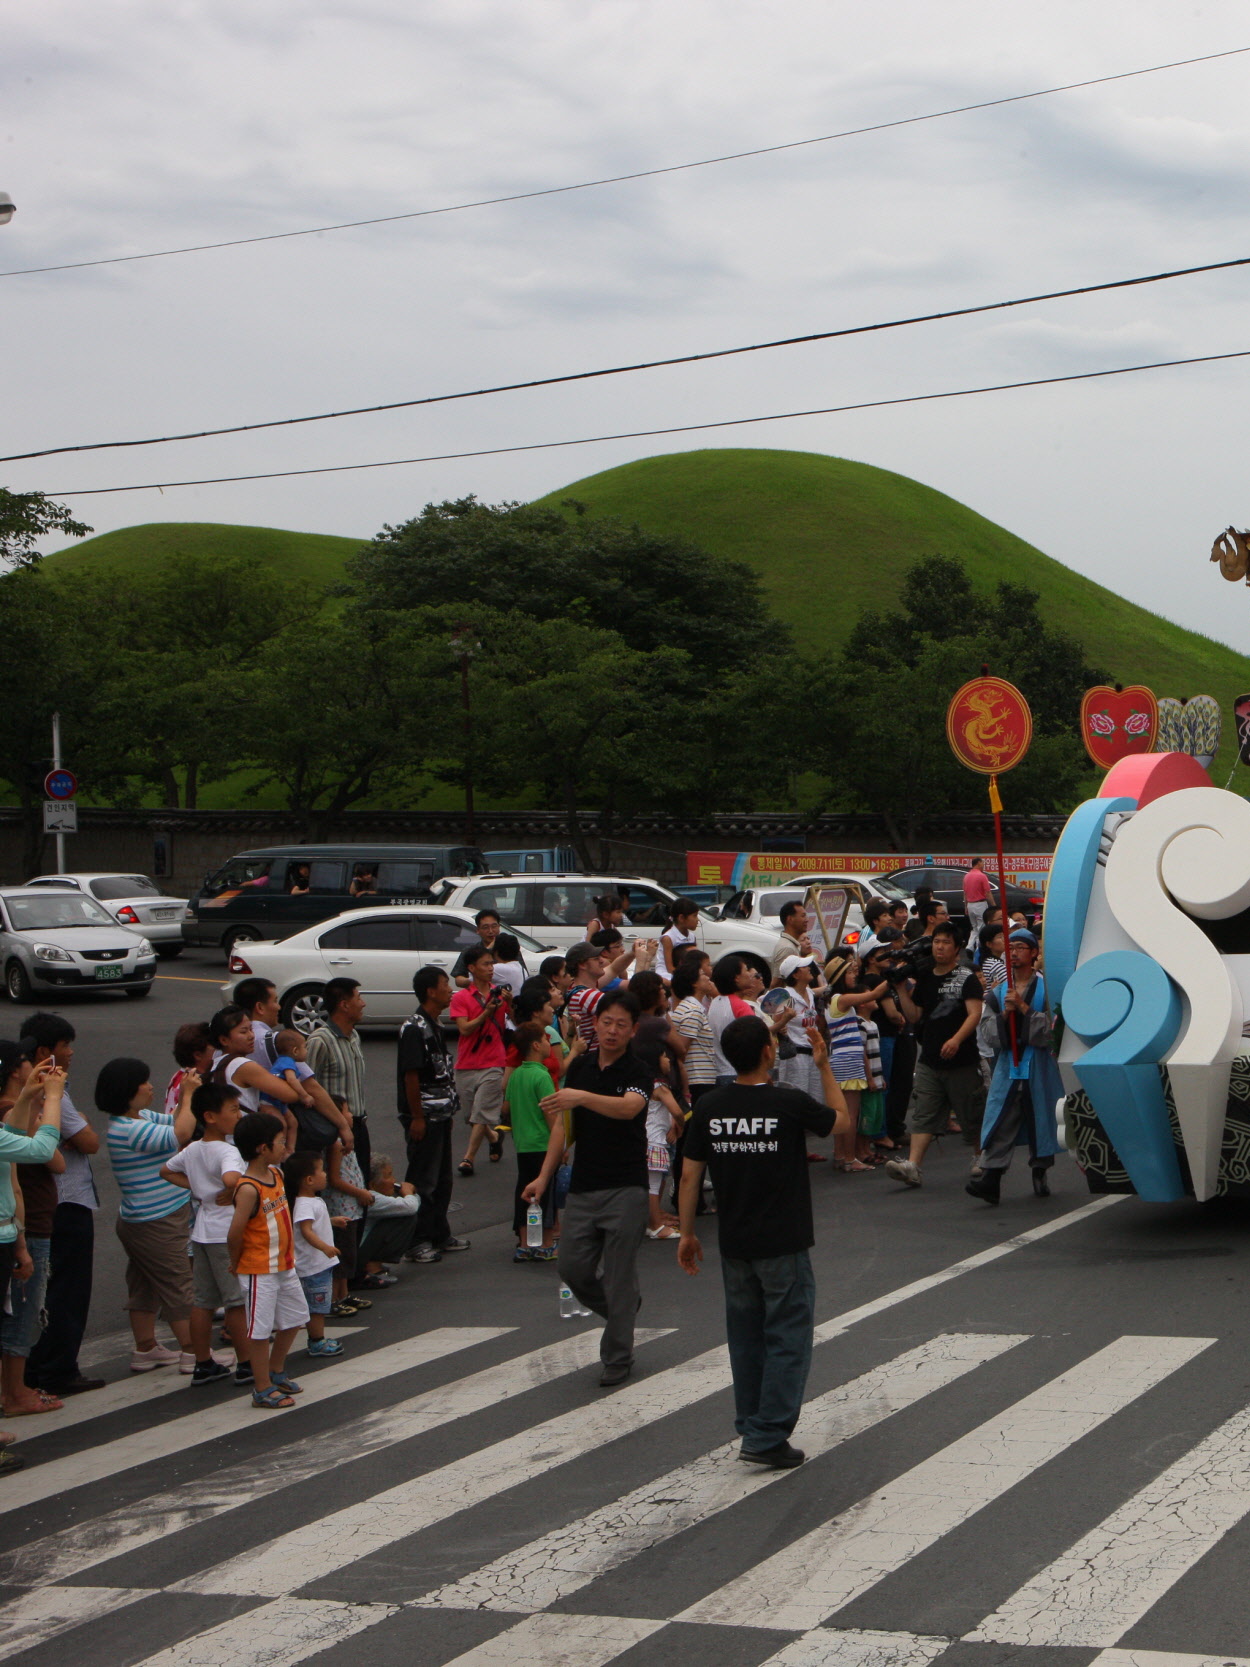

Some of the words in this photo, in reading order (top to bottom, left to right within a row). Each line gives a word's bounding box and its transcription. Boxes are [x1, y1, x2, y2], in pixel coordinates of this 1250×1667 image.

[46, 803, 75, 813] 견인지역
[757, 857, 791, 871] 통제일시
[797, 857, 846, 871] 2009.7.11(토)
[850, 858, 871, 870] 13:00
[876, 858, 900, 871] 16:35
[97, 969, 122, 979] 4583
[709, 1117, 779, 1136] STAFF
[711, 1141, 778, 1153] 전통문화진흥회
